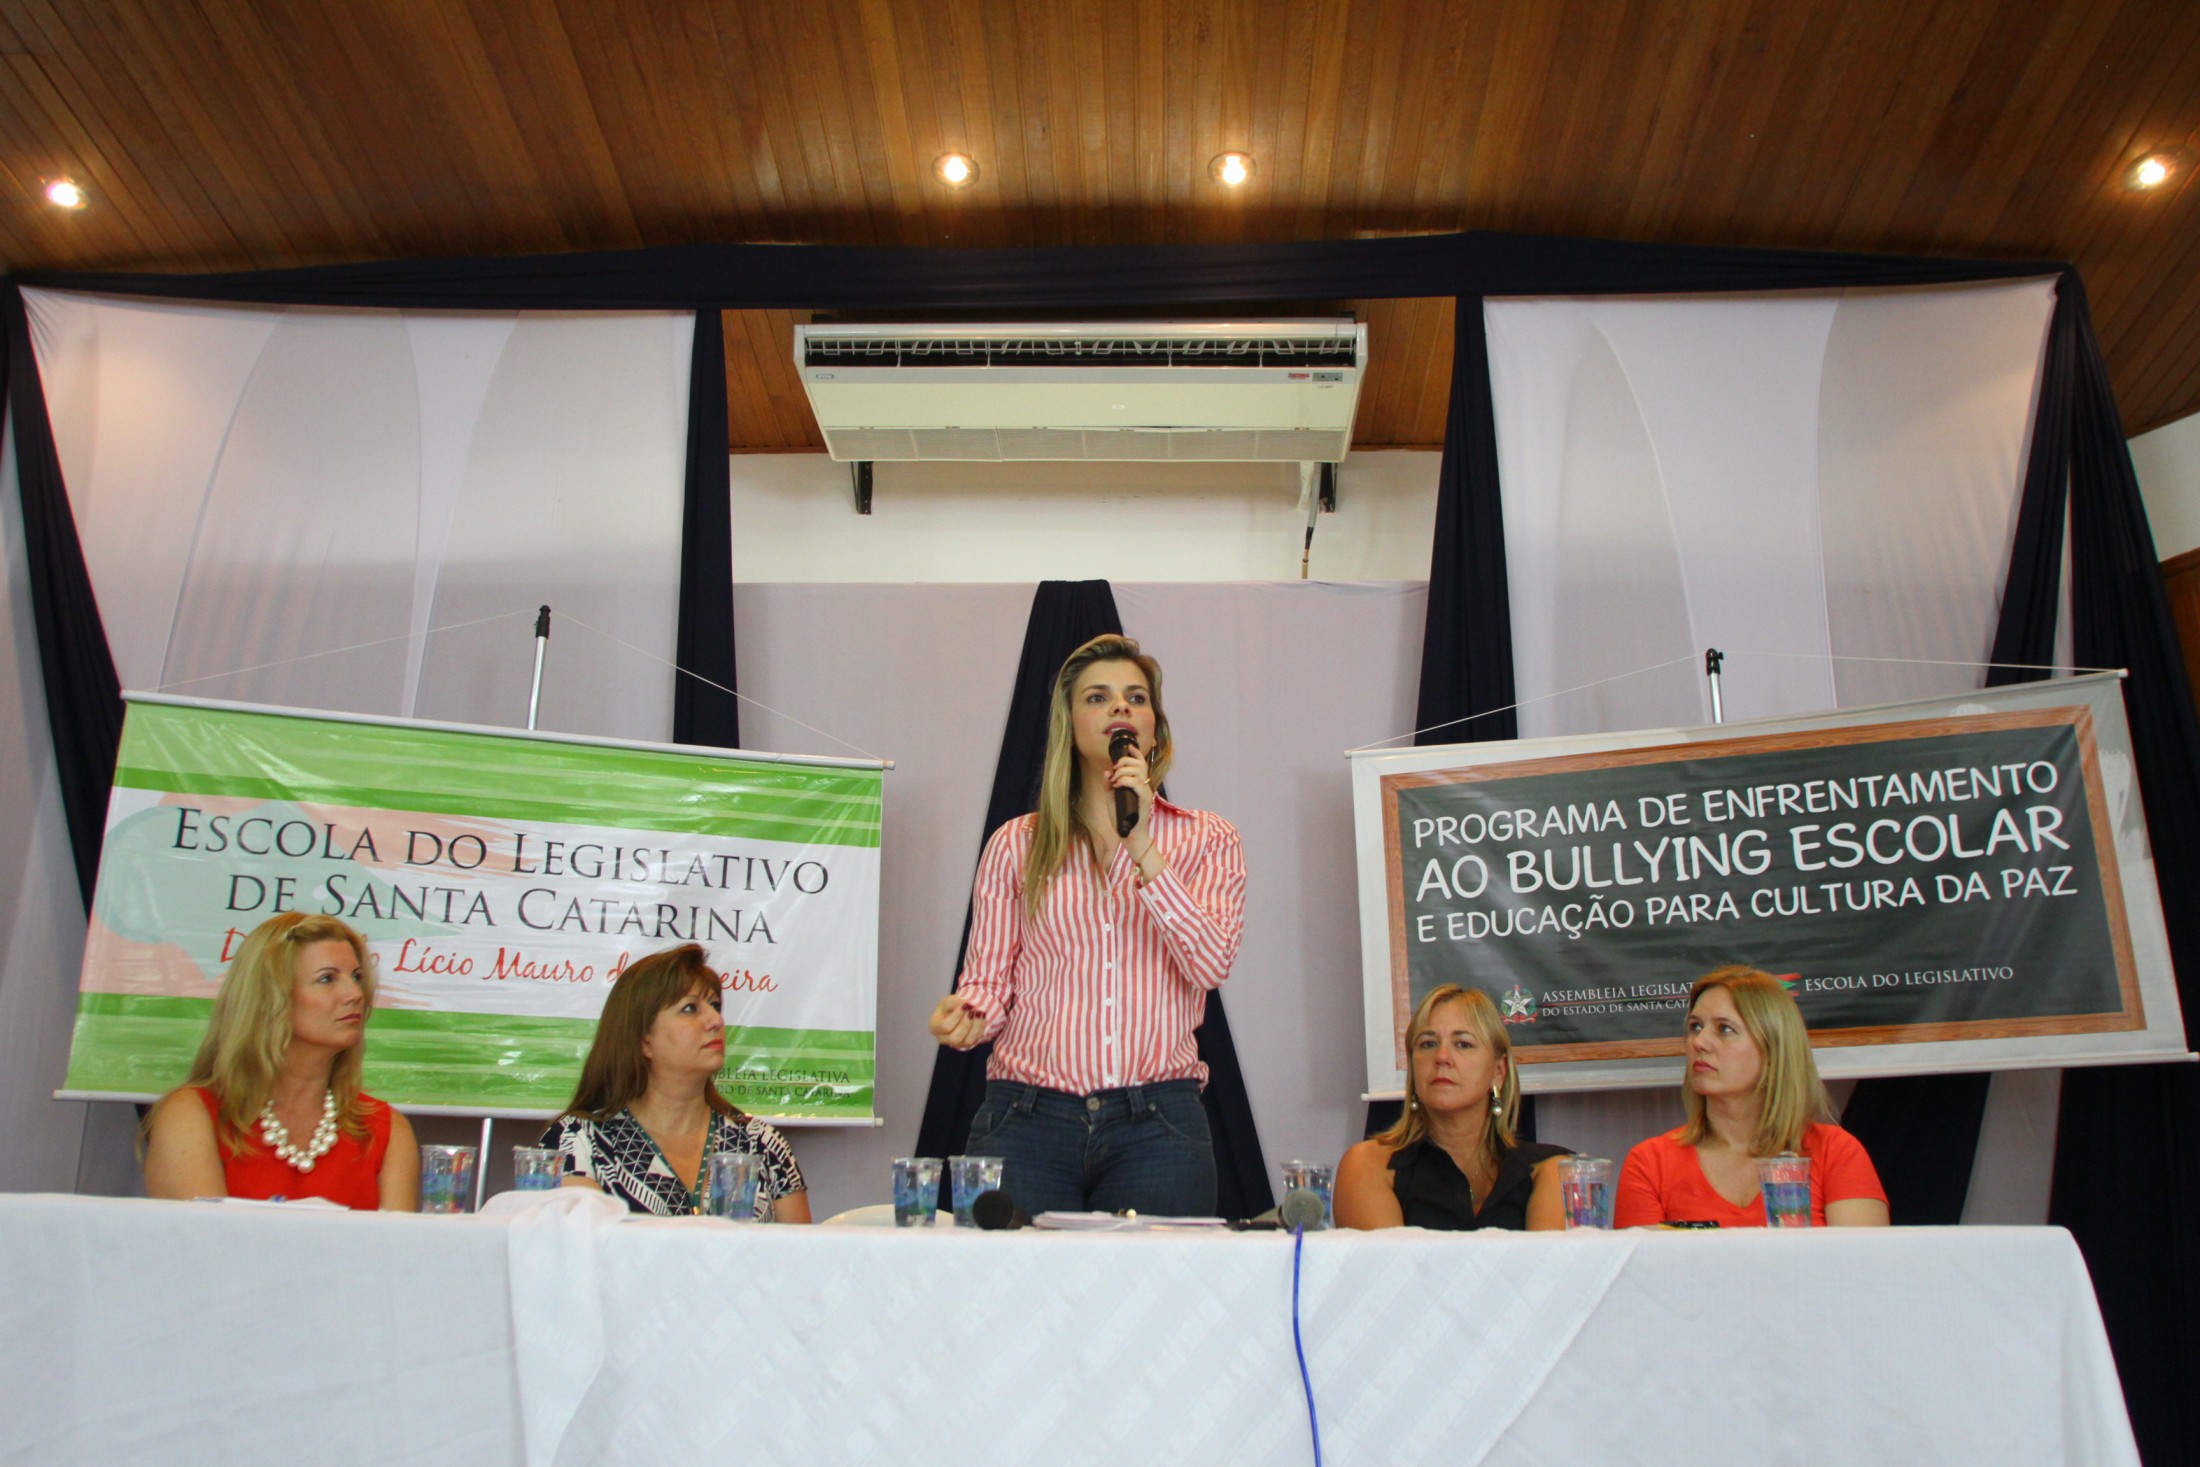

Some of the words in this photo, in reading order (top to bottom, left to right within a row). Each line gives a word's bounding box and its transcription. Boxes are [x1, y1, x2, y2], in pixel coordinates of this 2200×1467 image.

[1413, 800, 1627, 848] PROGRAMA
[1638, 793, 1691, 828] DE
[1702, 760, 2059, 822] ENFRENTAMENTO
[172, 806, 383, 863] ESCOLA
[404, 830, 488, 869] DO
[511, 832, 829, 895] LEGISLATIVO
[1416, 855, 1489, 902] AO
[1506, 829, 1772, 894] BULLYING
[1790, 805, 2070, 871] ESCOLAR
[225, 873, 297, 913] DE
[321, 873, 498, 926] SANTA
[517, 887, 778, 944] CATARINA
[1417, 914, 1437, 942] E
[1446, 894, 1635, 941] EDUCAÇÃO
[1645, 891, 1741, 926] PARA
[1751, 876, 1926, 918] CULTURA
[1935, 871, 1991, 904] DA
[2000, 865, 2078, 899] PAZ
[393, 937, 474, 976] Lício
[483, 947, 594, 983] Mauro
[1805, 975, 1868, 992] ESCOLA
[1872, 973, 1900, 988] DO
[1905, 966, 2014, 986] LEGISLATIVO
[1542, 986, 1626, 1003] ASSEMBLEIA
[1631, 981, 1696, 997] LEGISLAT
[1542, 1006, 1560, 1017] DO
[1563, 1004, 1606, 1016] ESTADO
[1609, 1002, 1624, 1013] DE
[1627, 1000, 1663, 1012] SANTA
[738, 1085, 752, 1095] DE
[756, 1085, 791, 1097] SANTA
[762, 1069, 850, 1084] LEGISLATIVA
